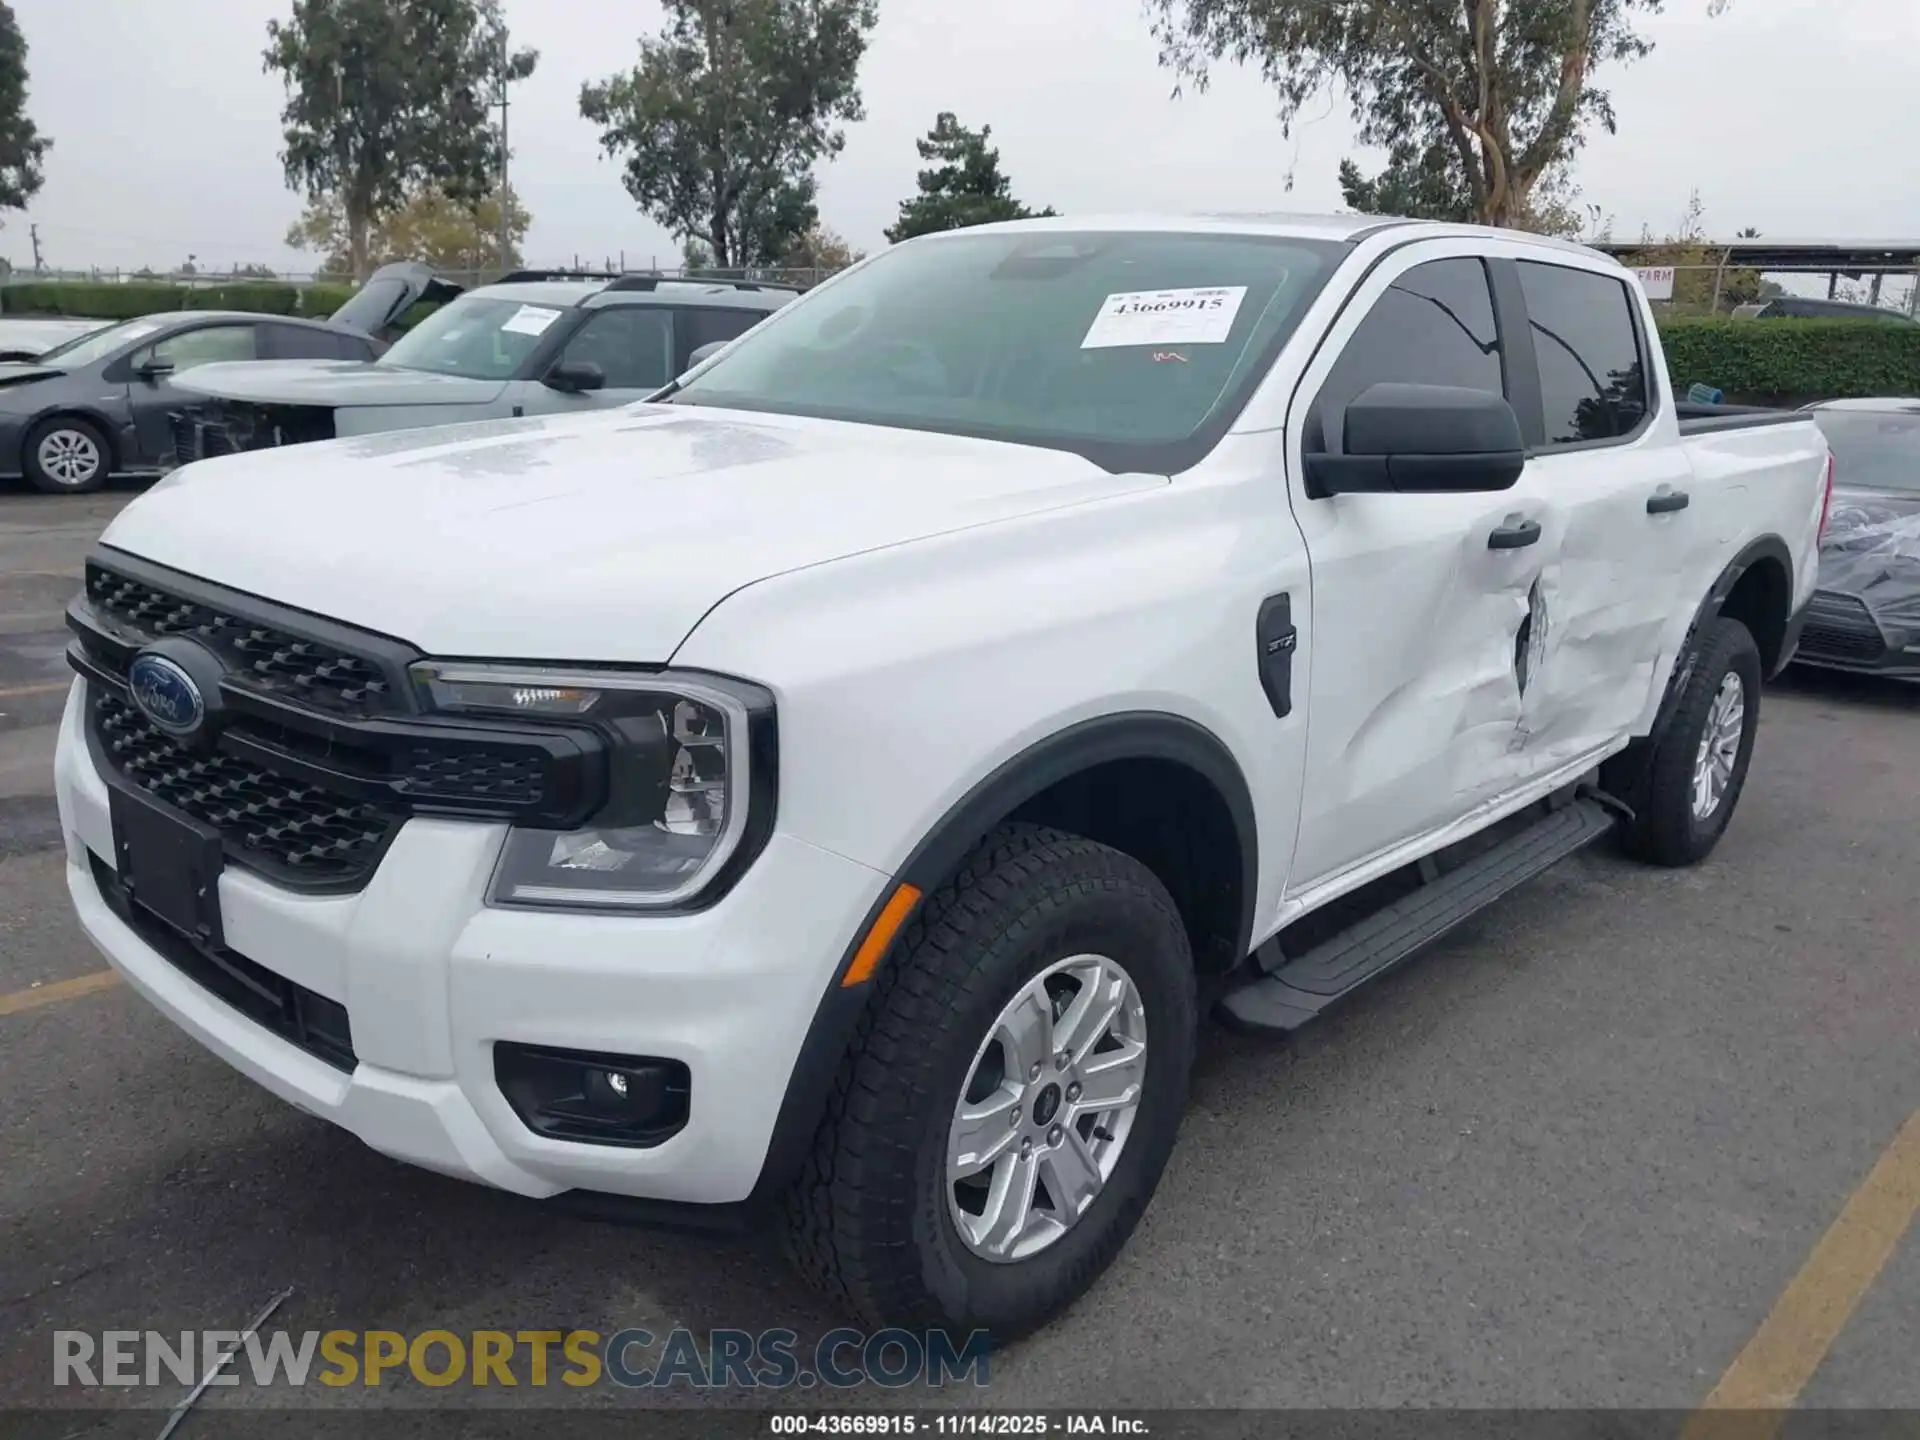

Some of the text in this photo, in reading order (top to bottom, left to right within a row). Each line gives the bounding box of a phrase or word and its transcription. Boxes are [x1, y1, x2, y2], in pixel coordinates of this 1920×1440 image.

[1638, 270, 1672, 281] FARM
[1113, 298, 1224, 315] 43669915
[140, 669, 181, 719] Ford
